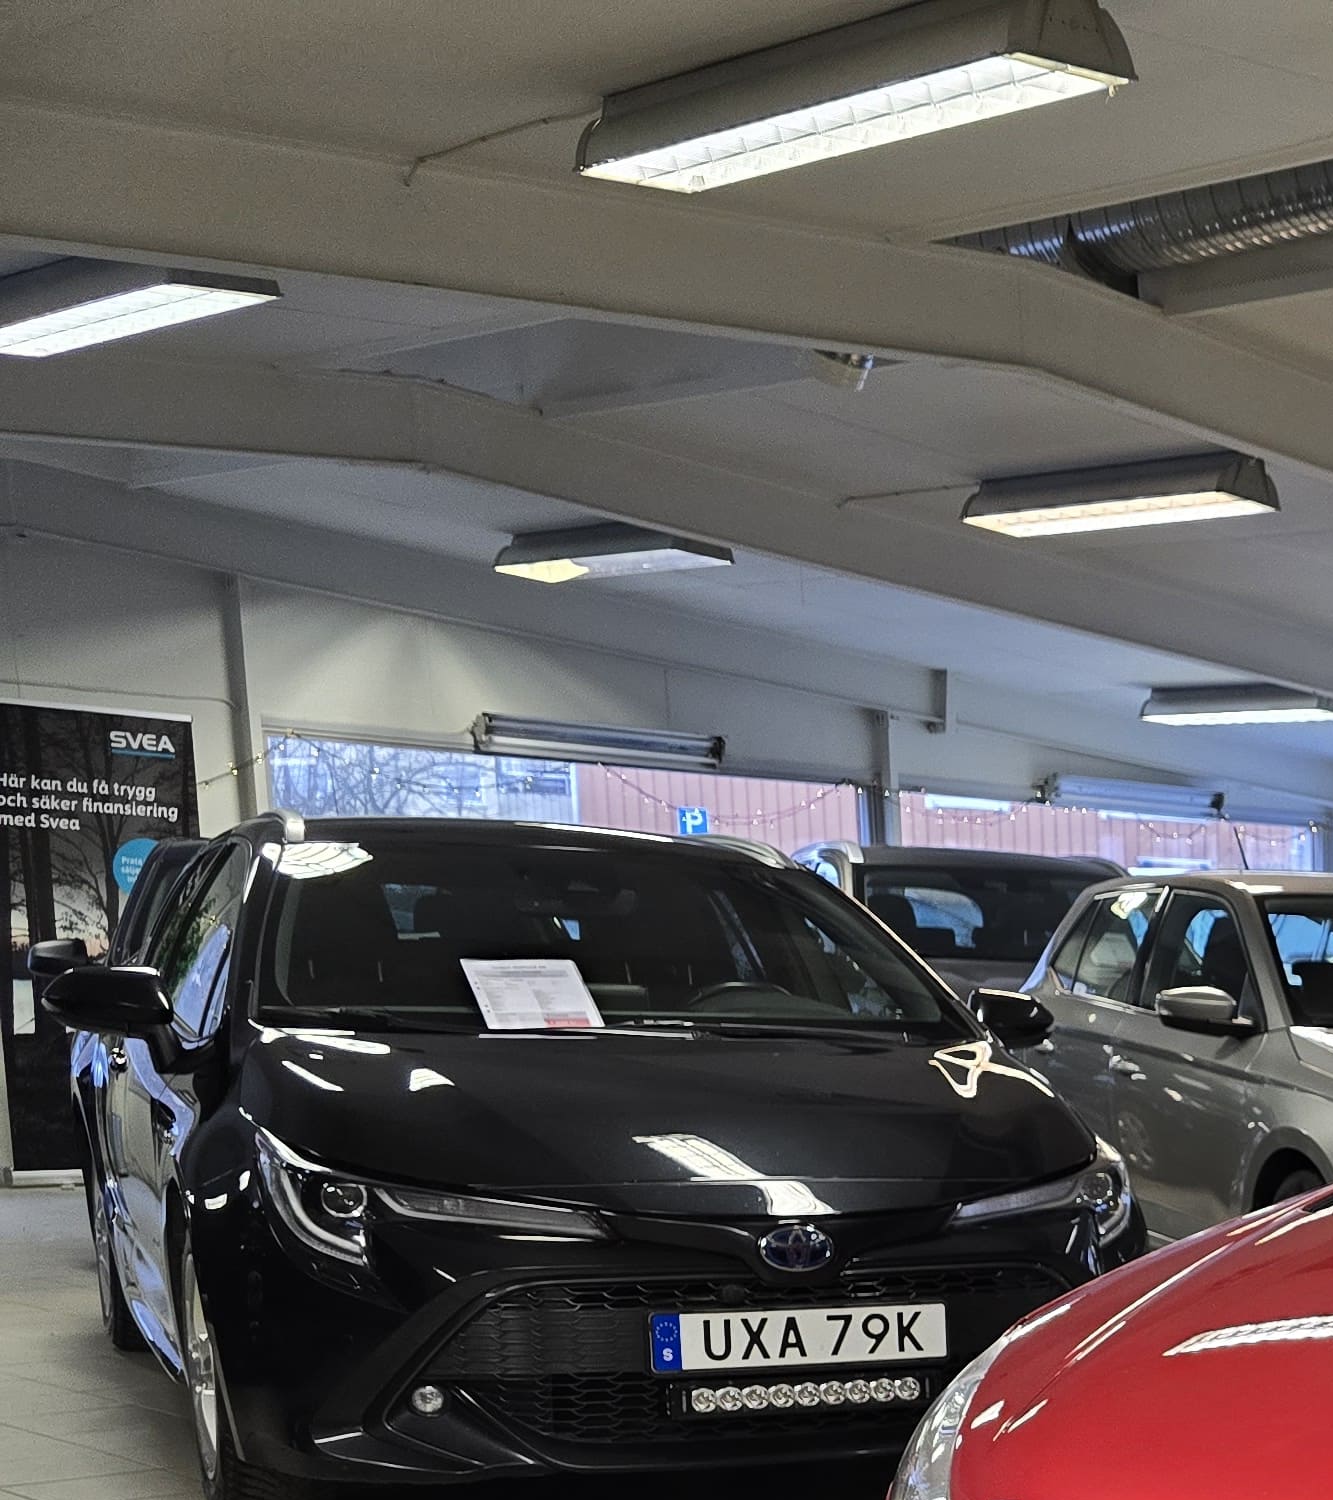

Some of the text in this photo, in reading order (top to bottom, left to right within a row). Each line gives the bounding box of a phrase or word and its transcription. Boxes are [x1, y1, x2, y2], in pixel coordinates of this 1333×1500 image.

[109, 730, 176, 753] SVEA
[31, 774, 62, 792] kan
[66, 777, 88, 794] du
[92, 778, 109, 796] få
[113, 782, 156, 802] trygg
[31, 794, 78, 812] säker
[82, 797, 179, 823] finansiering
[40, 814, 81, 832] Svea
[702, 1310, 925, 1362] UXA 79K
[662, 1347, 674, 1362] S
